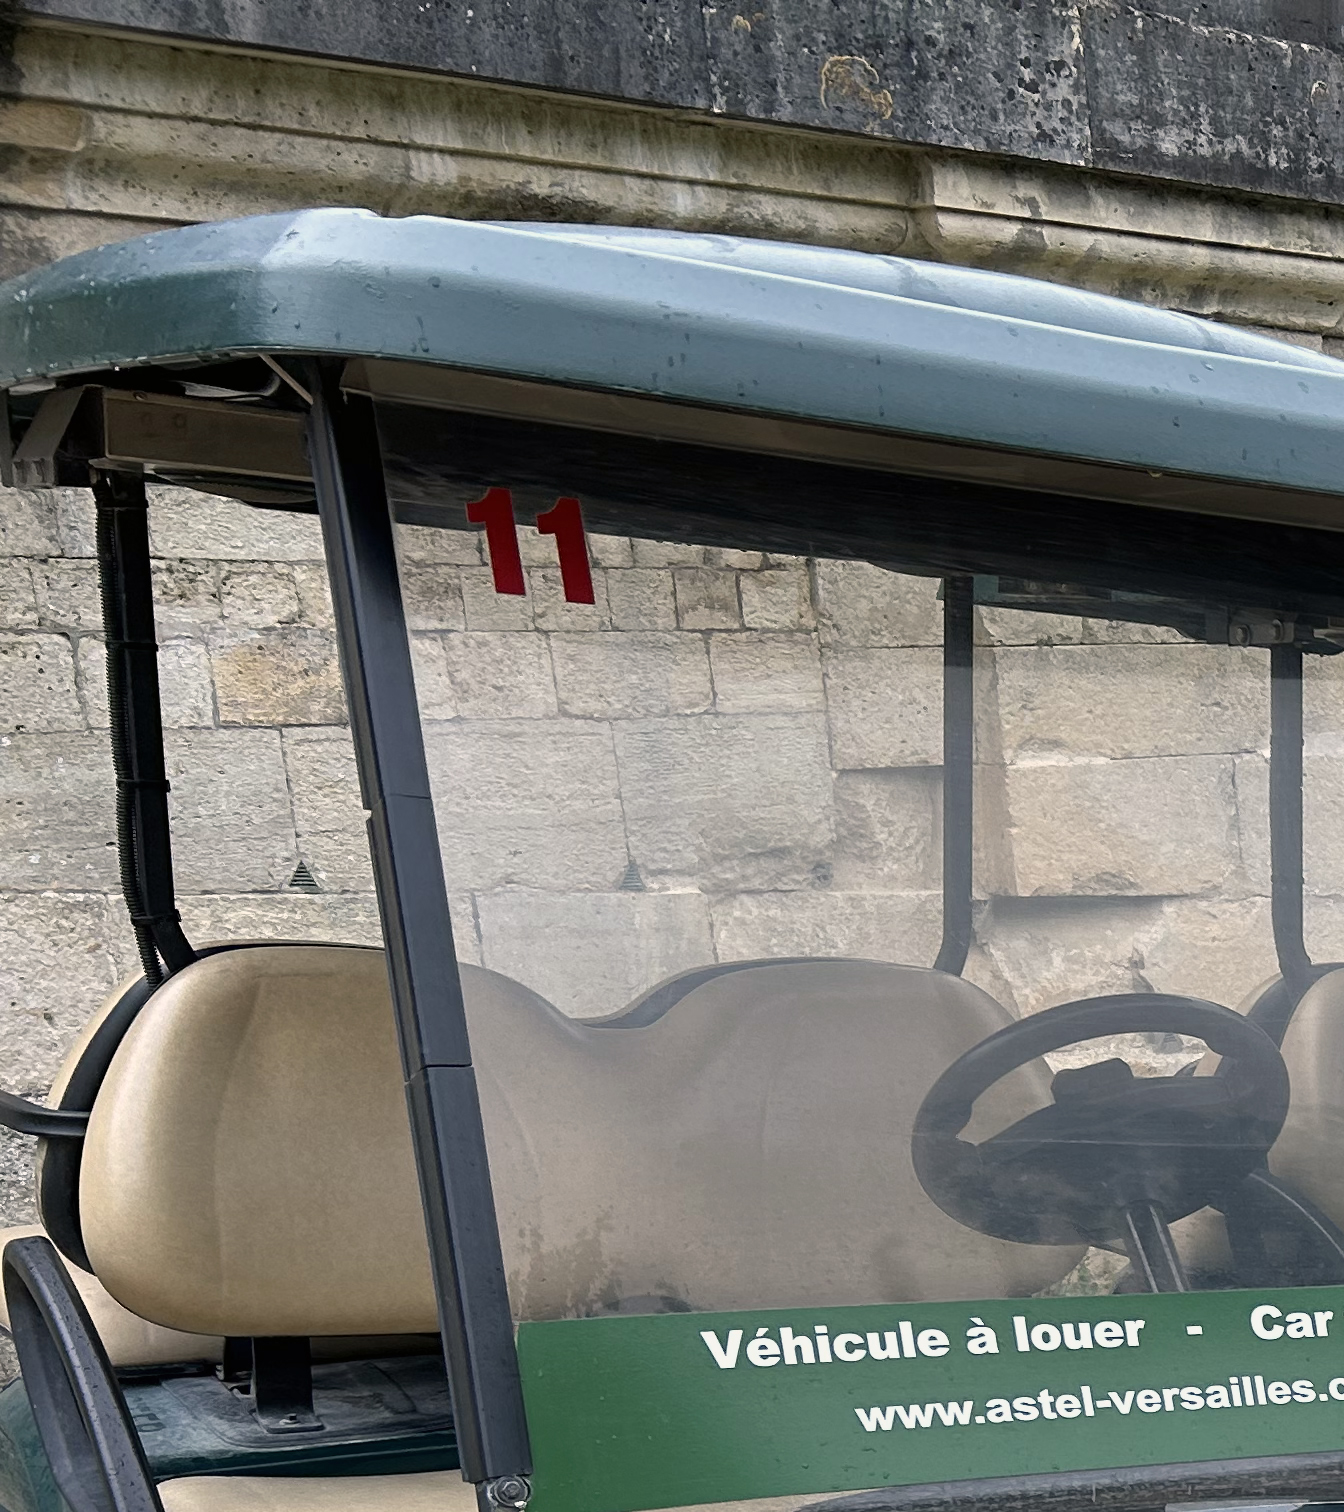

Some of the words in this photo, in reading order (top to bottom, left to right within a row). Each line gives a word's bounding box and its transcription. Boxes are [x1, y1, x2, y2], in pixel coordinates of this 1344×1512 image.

[465, 486, 595, 605] 11
[699, 1320, 951, 1370] Véhicule
[965, 1316, 1001, 1355] à
[1012, 1315, 1146, 1353] louer
[1249, 1303, 1334, 1341] Car
